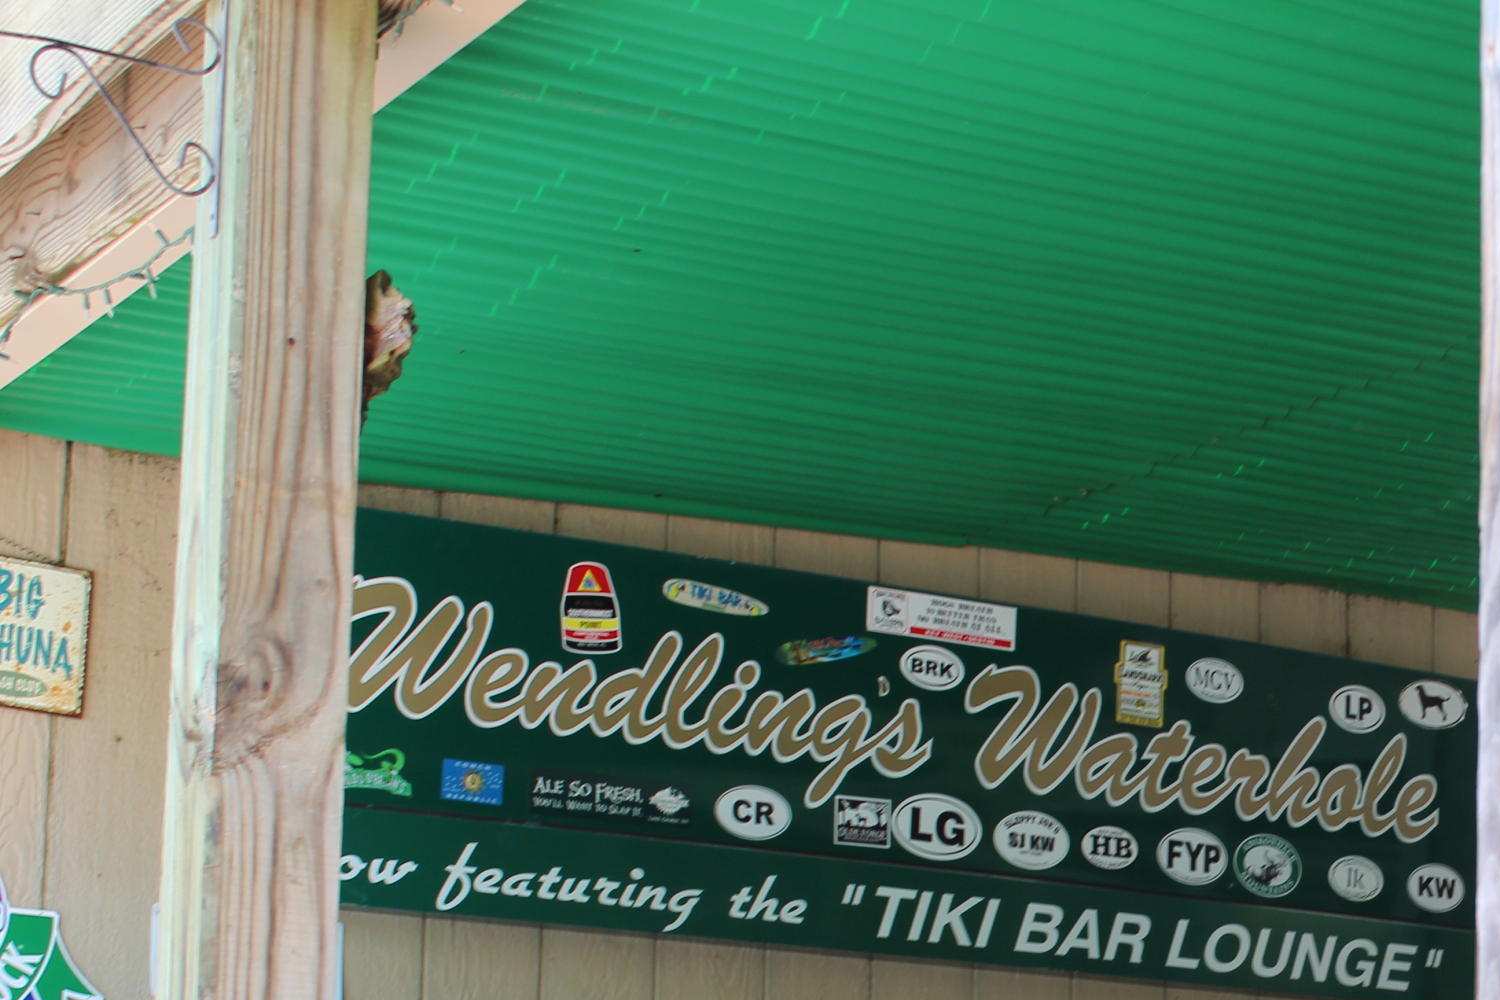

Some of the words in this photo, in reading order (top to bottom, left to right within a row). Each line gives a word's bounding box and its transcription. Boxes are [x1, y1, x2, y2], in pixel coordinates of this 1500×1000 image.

[0, 569, 44, 619] BIG
[911, 657, 955, 679] BRK
[346, 575, 933, 809] Wendling's
[964, 664, 1440, 843] Waterhole
[1344, 693, 1373, 721] LP
[532, 776, 564, 795] ALE
[567, 780, 592, 798] SO
[733, 799, 774, 826] CR
[910, 806, 965, 847] LG
[1090, 834, 1133, 859] HB
[1167, 839, 1221, 875] FYP
[1418, 876, 1457, 900] KW
[339, 852, 419, 885] ow
[436, 842, 704, 932] featuring
[728, 874, 808, 925] the
[841, 883, 1001, 949] "TIKI
[1014, 902, 1152, 964] BAR
